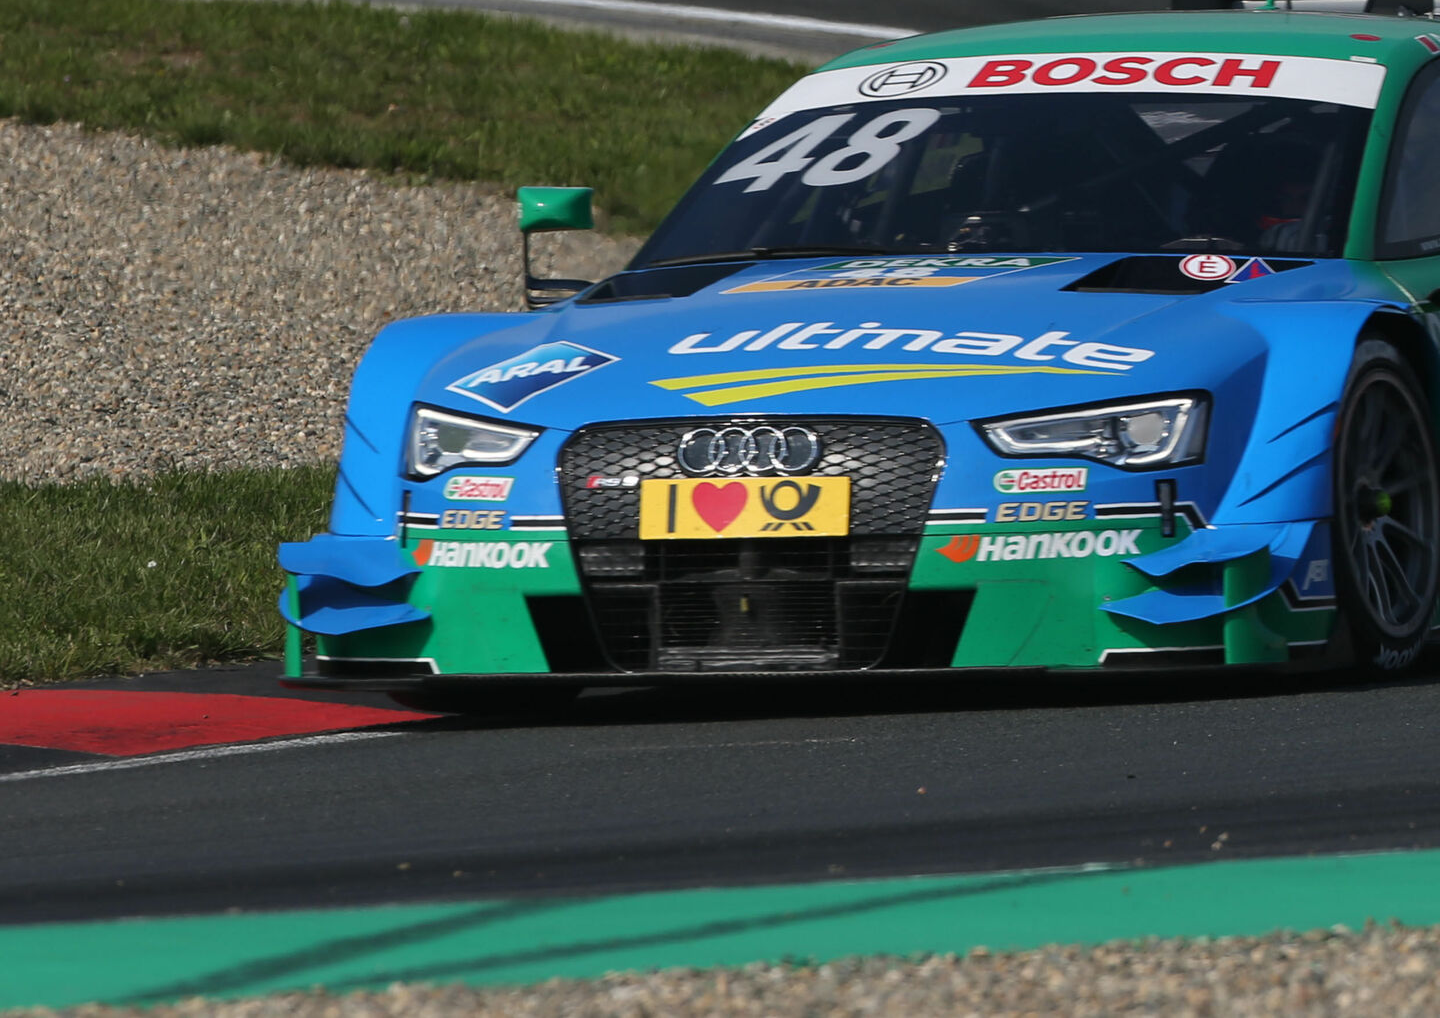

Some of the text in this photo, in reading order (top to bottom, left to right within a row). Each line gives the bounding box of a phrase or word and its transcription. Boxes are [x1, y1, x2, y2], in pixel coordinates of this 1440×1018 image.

[967, 57, 1283, 89] BOSCH
[713, 107, 943, 194] 48
[848, 256, 1032, 270] DEKRA
[787, 276, 919, 290] ADAC
[668, 321, 1156, 371] ultimate
[467, 356, 593, 387] ARAL
[1016, 468, 1087, 492] Castrol
[440, 510, 507, 530] EDGE
[994, 501, 1090, 522] EDGE
